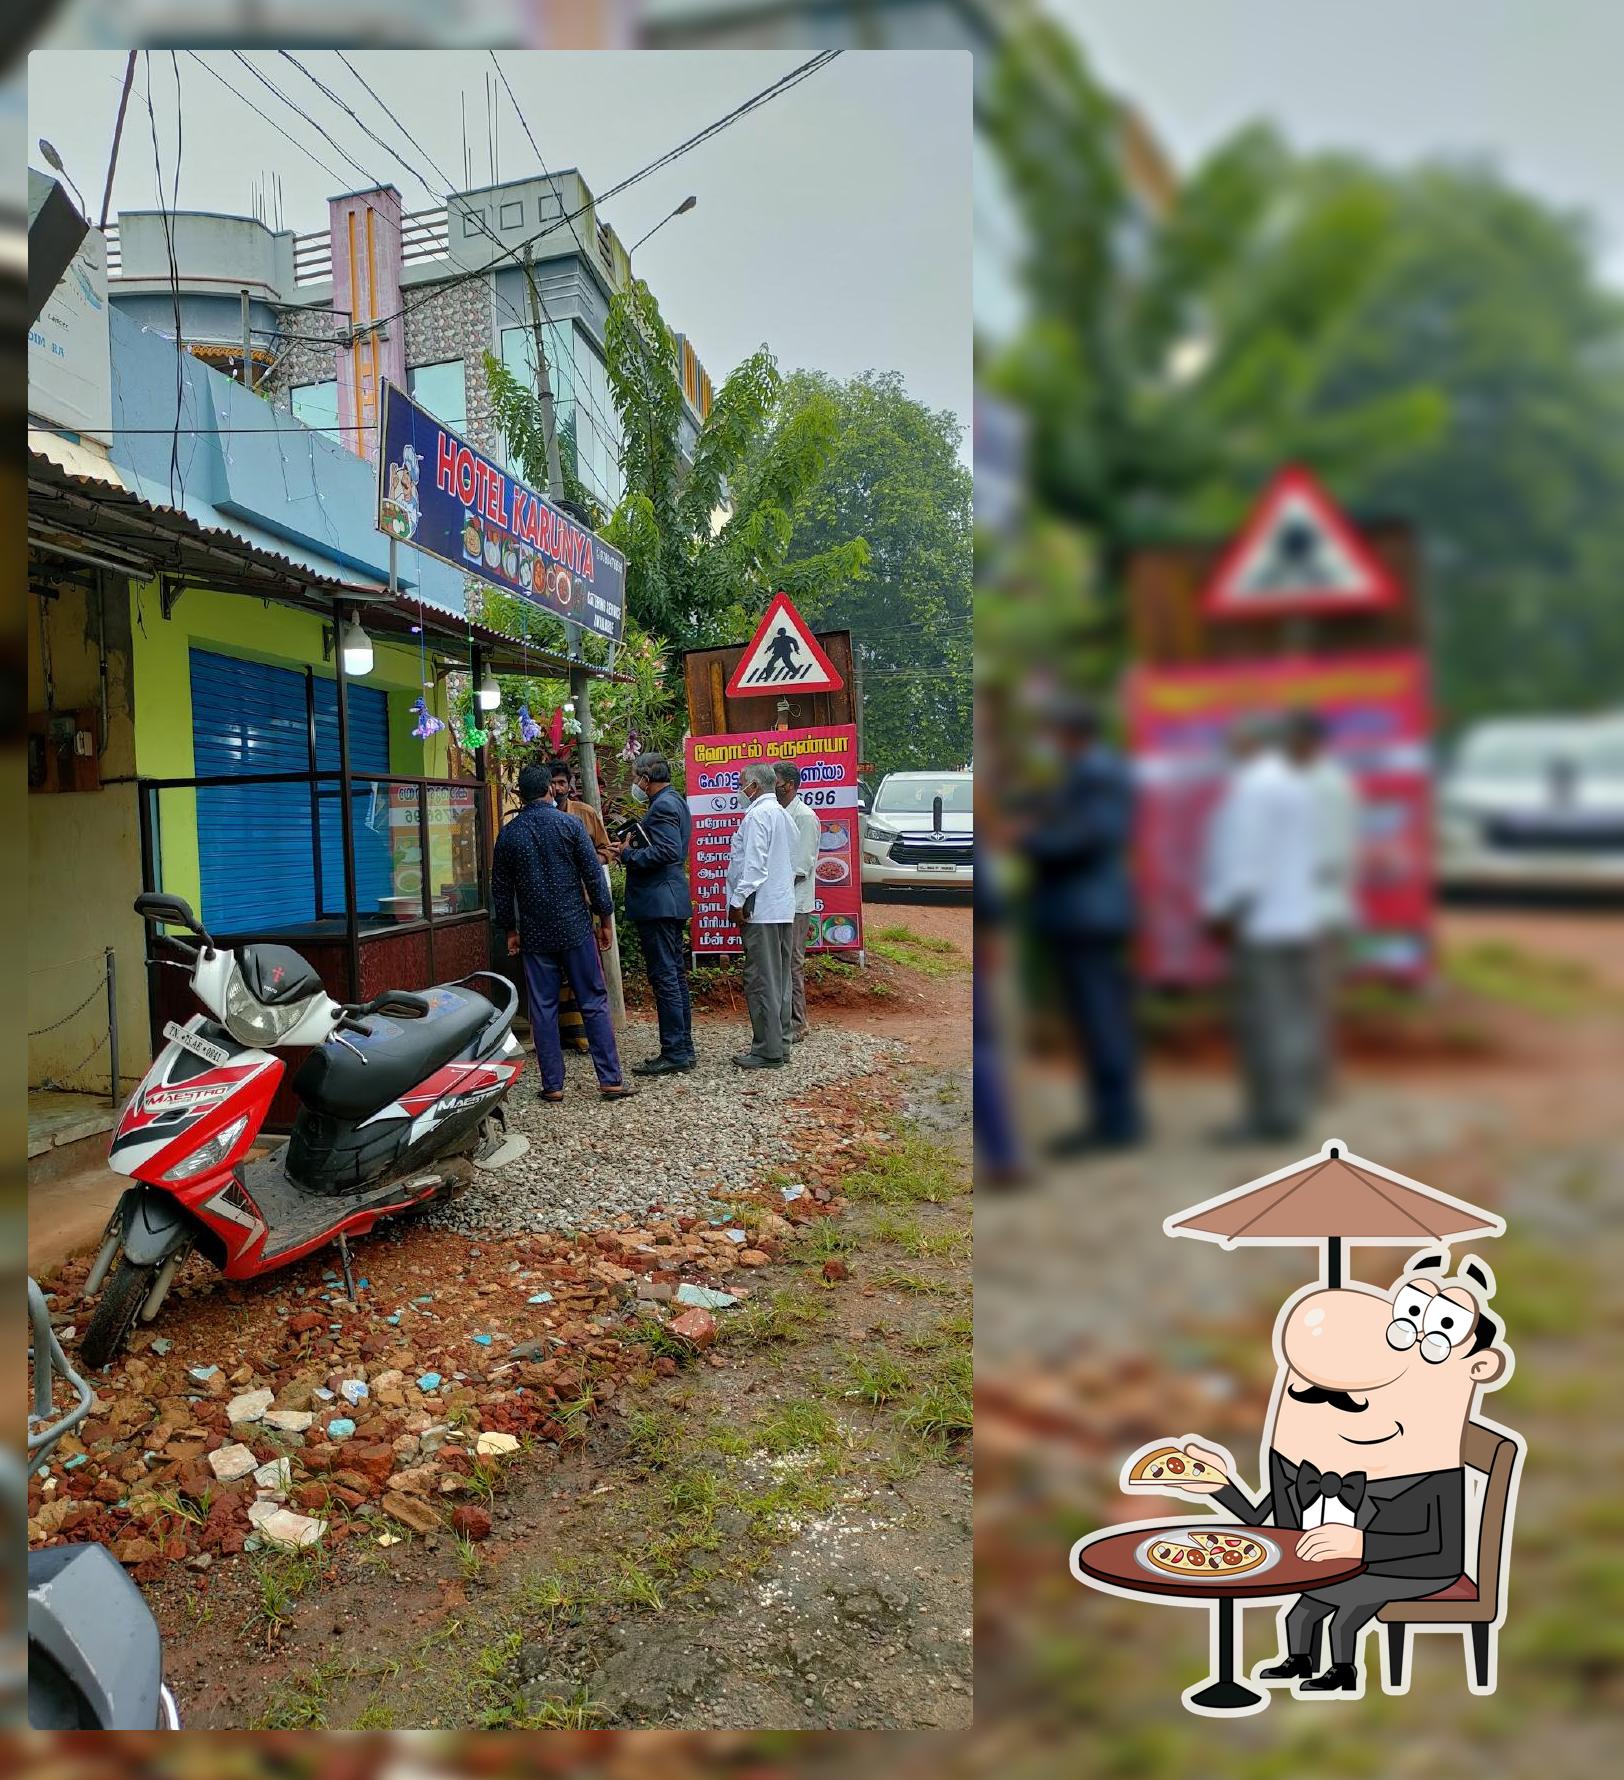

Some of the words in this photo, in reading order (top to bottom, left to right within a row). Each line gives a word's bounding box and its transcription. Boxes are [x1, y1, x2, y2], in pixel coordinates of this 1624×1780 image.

[437, 431, 508, 529] HOTEL
[512, 486, 595, 583] KARUNYA
[146, 1087, 227, 1105] MAESTRO
